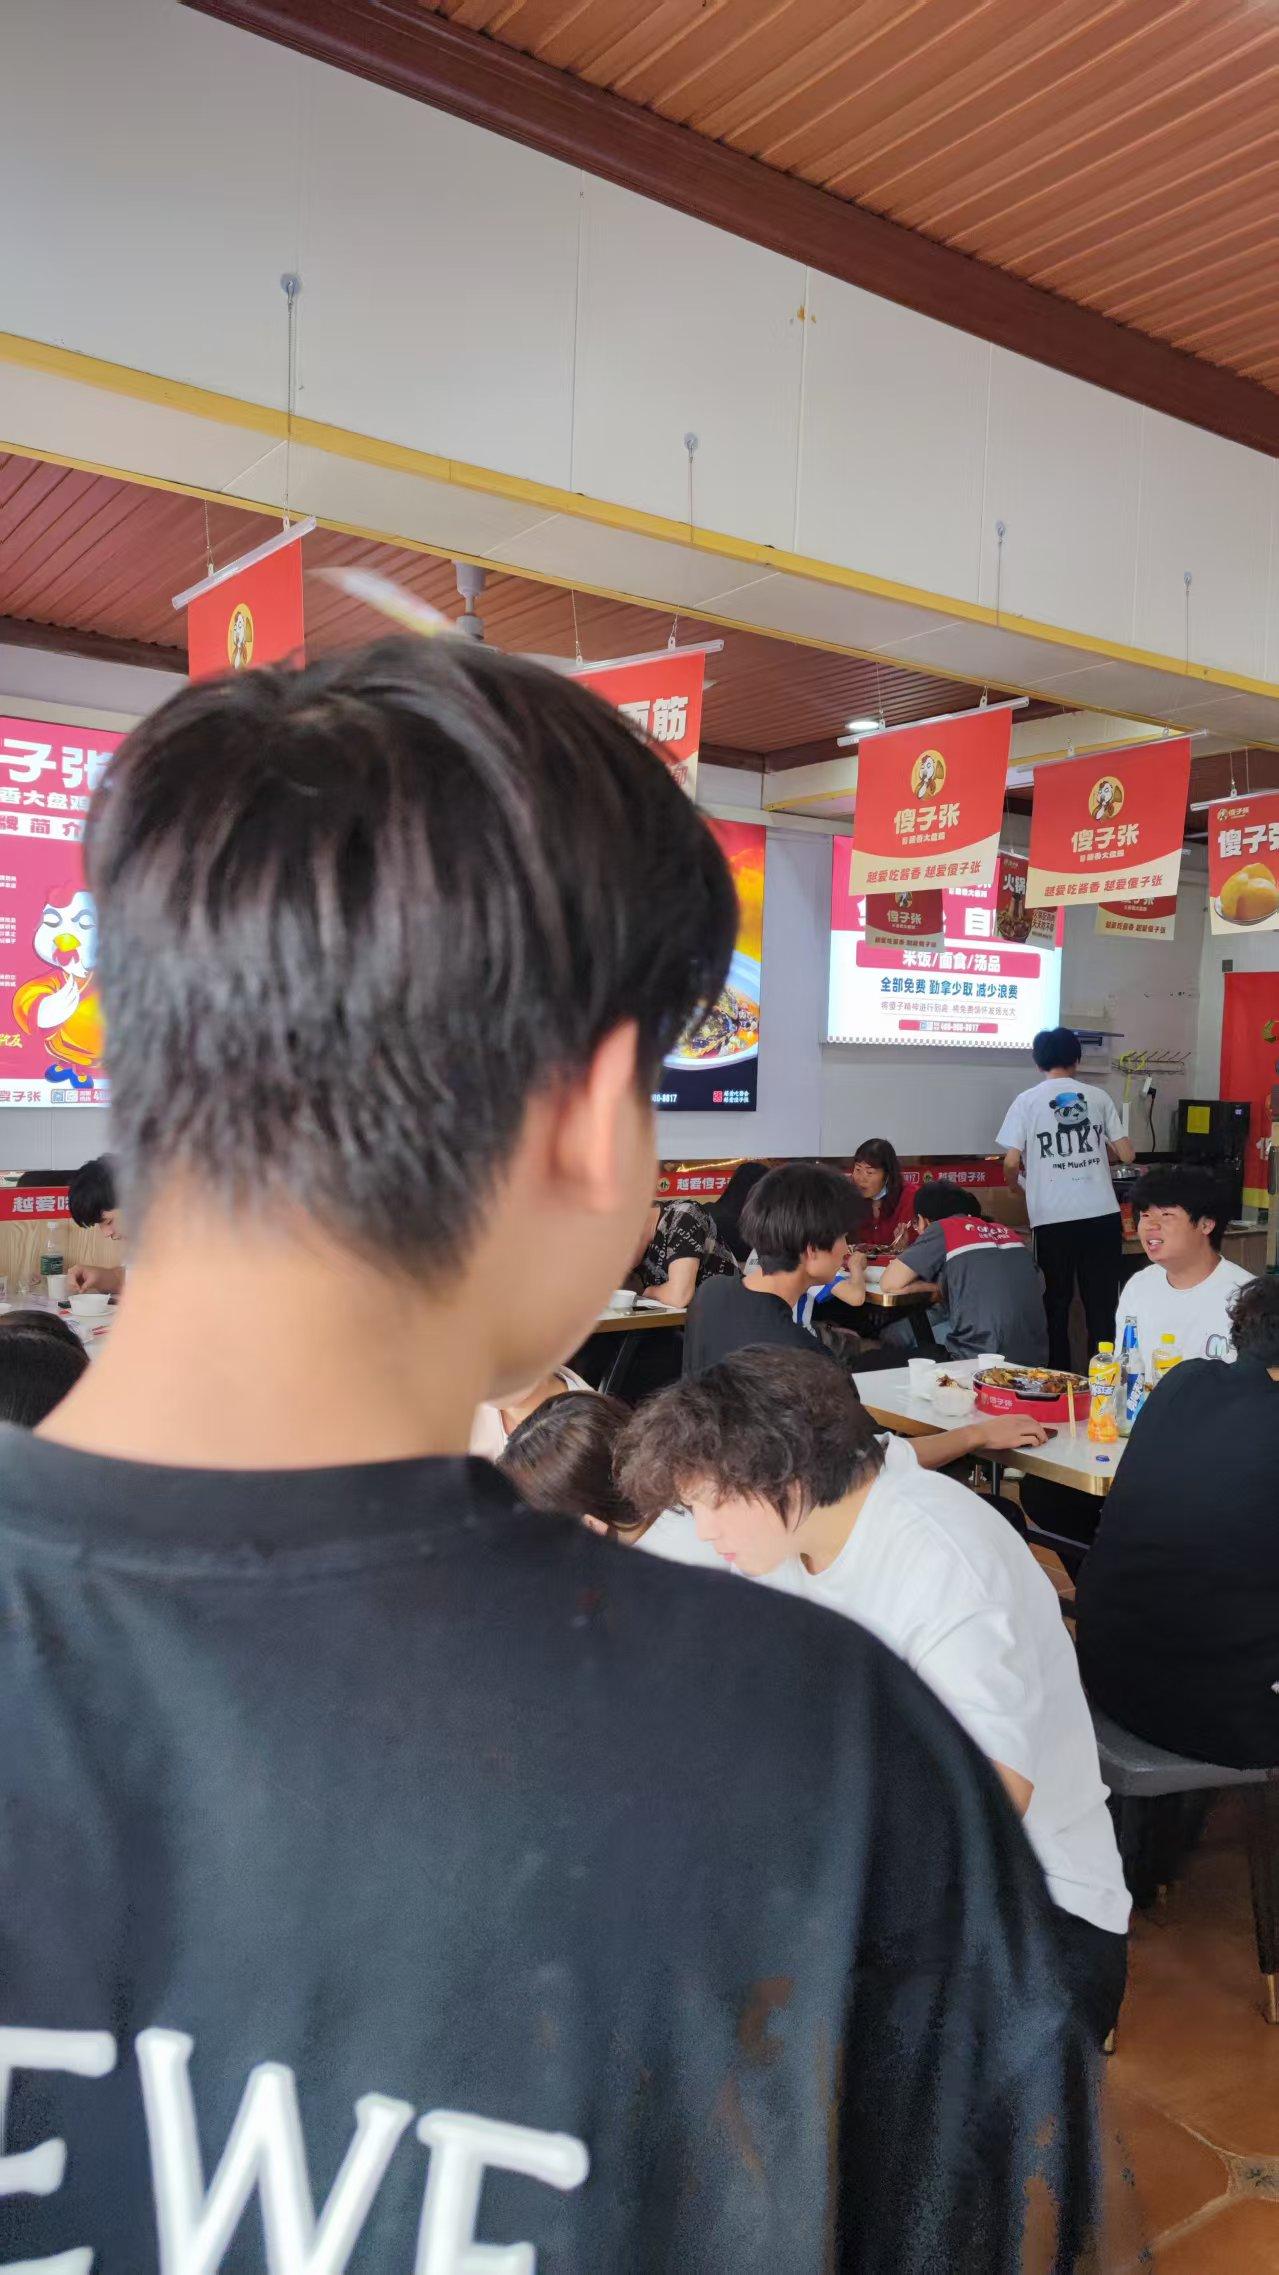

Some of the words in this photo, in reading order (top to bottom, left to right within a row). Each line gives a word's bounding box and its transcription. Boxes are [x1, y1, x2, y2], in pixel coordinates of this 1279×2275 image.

[893, 803, 961, 835] 傻子张
[1071, 823, 1139, 853] 傻子张
[866, 867, 921, 884] 越爱吃酱香
[924, 859, 982, 879] 越爱傻子张
[1044, 881, 1101, 897] 越爱吃酱香
[1103, 874, 1163, 892] 越爱傻子张
[902, 950, 1001, 973] 米饭/面食/汤品
[880, 976, 926, 994] 全部免费
[929, 979, 973, 998] 勤拿少取
[976, 982, 1018, 1000] 减少浪费
[1036, 1124, 1103, 1158] ROKY
[676, 1177, 731, 1191] 越爱傻子
